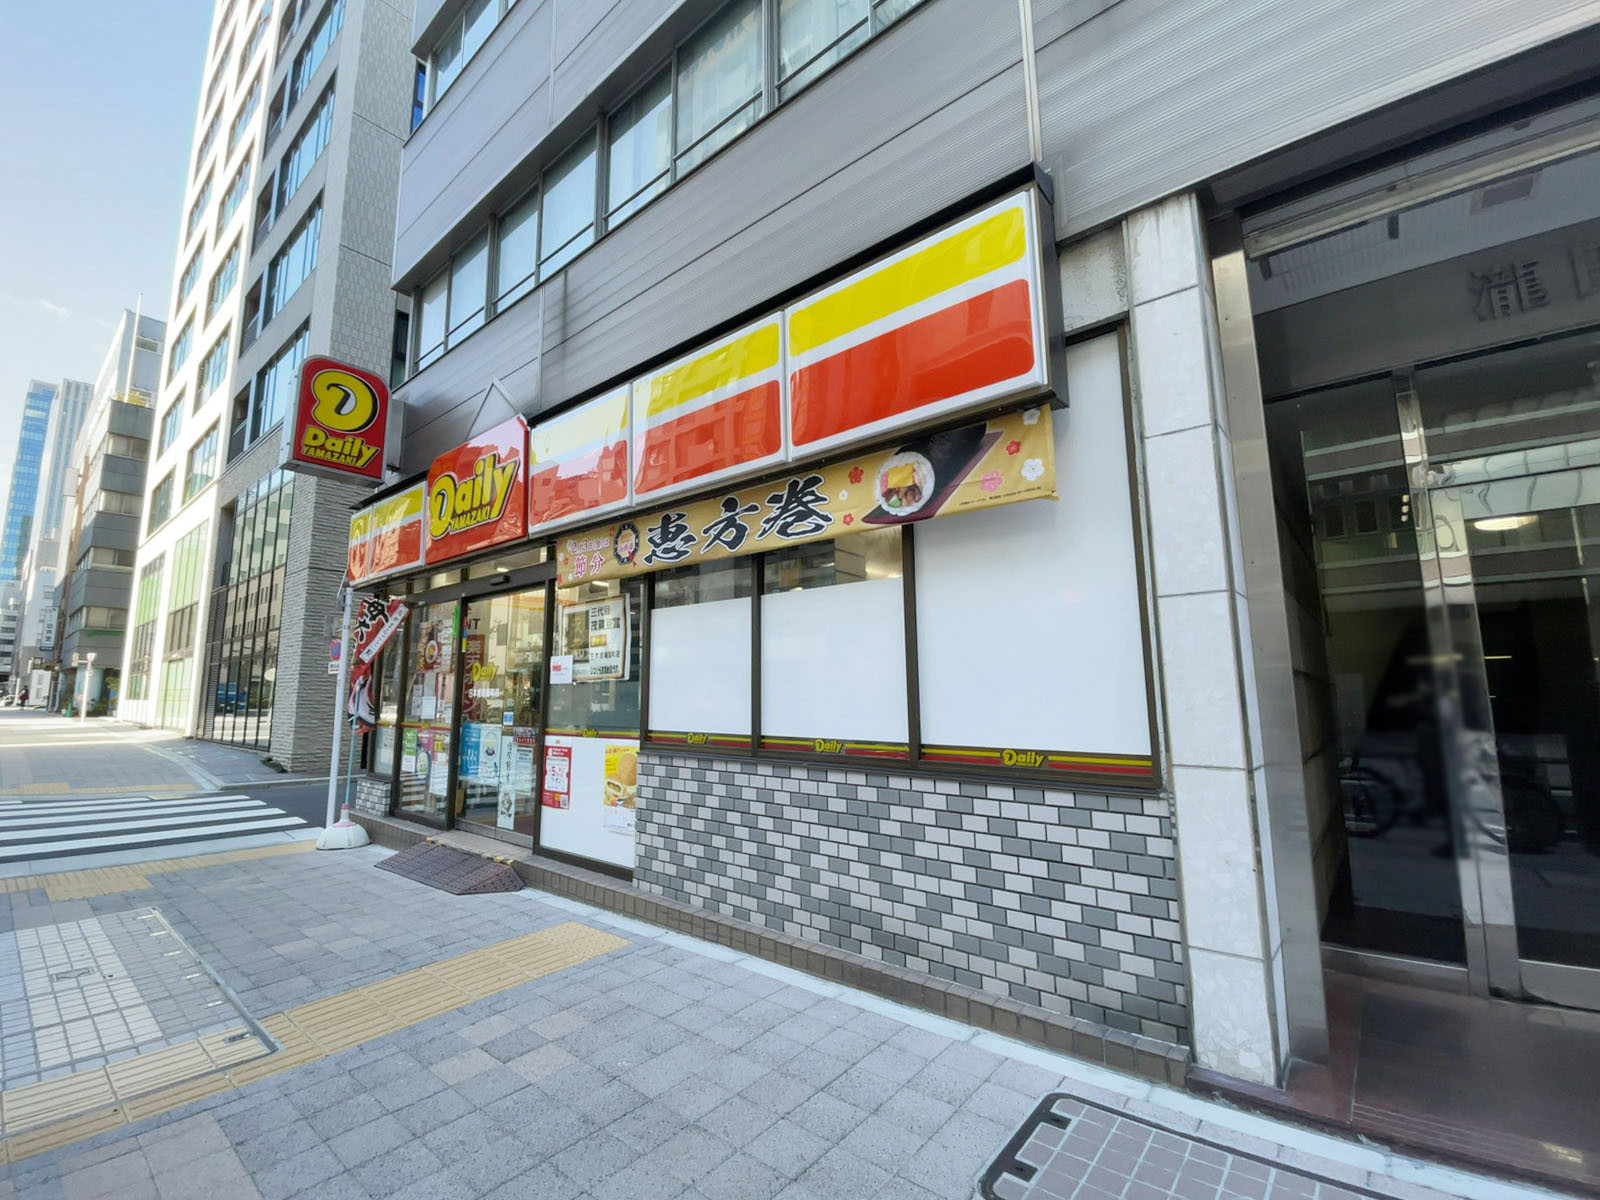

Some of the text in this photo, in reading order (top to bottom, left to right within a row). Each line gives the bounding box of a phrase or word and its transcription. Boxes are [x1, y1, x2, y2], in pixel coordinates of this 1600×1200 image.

[302, 425, 381, 469] Daily
[302, 446, 357, 465] YAMAZAKI
[430, 453, 519, 539] Daily
[451, 507, 491, 532] YAMAZAKI
[643, 473, 834, 566] 恵方巻
[574, 552, 605, 577] 節分
[472, 661, 498, 682] Daily
[687, 732, 708, 744] Daily
[815, 738, 843, 753] Daily
[1002, 749, 1045, 768] Daily
